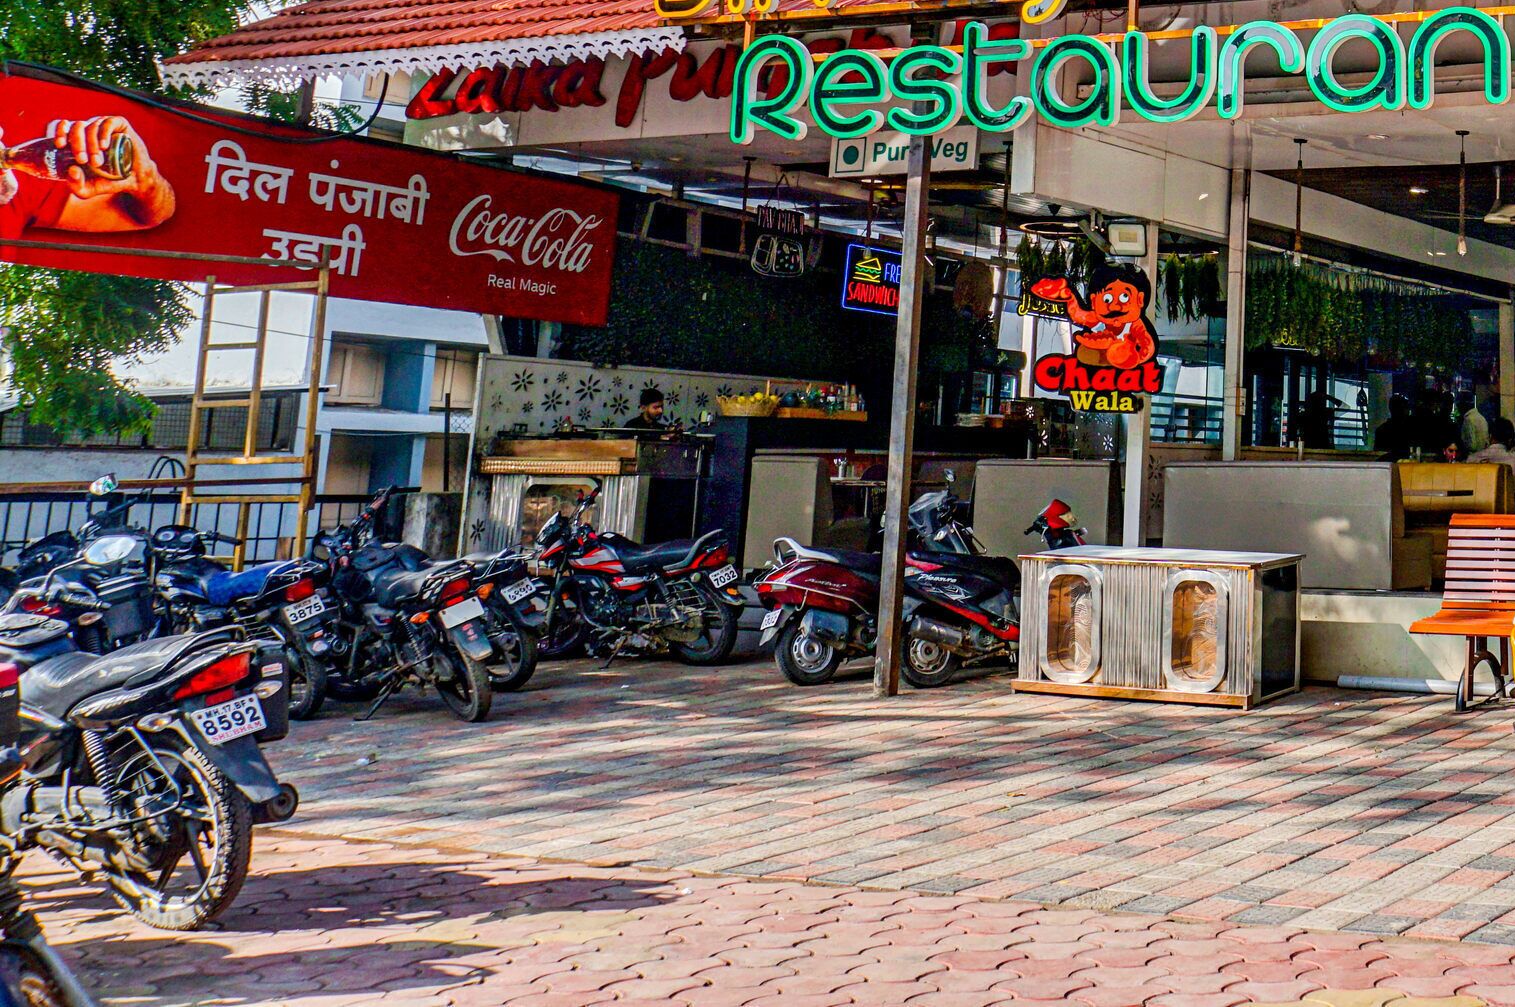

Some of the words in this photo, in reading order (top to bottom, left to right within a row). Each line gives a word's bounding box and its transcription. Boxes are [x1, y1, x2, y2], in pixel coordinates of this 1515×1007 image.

[872, 142, 910, 163] Pur
[205, 140, 294, 205] दिल
[308, 159, 430, 225] पंजाबी
[449, 195, 602, 274] Coca-Cola
[488, 274, 517, 290] Real
[519, 278, 557, 296] Magic
[1035, 356, 1161, 393] Chaat
[1071, 390, 1135, 412] Wala
[713, 570, 738, 586] 7032
[289, 602, 322, 622] 3875
[202, 706, 261, 736] 8592
